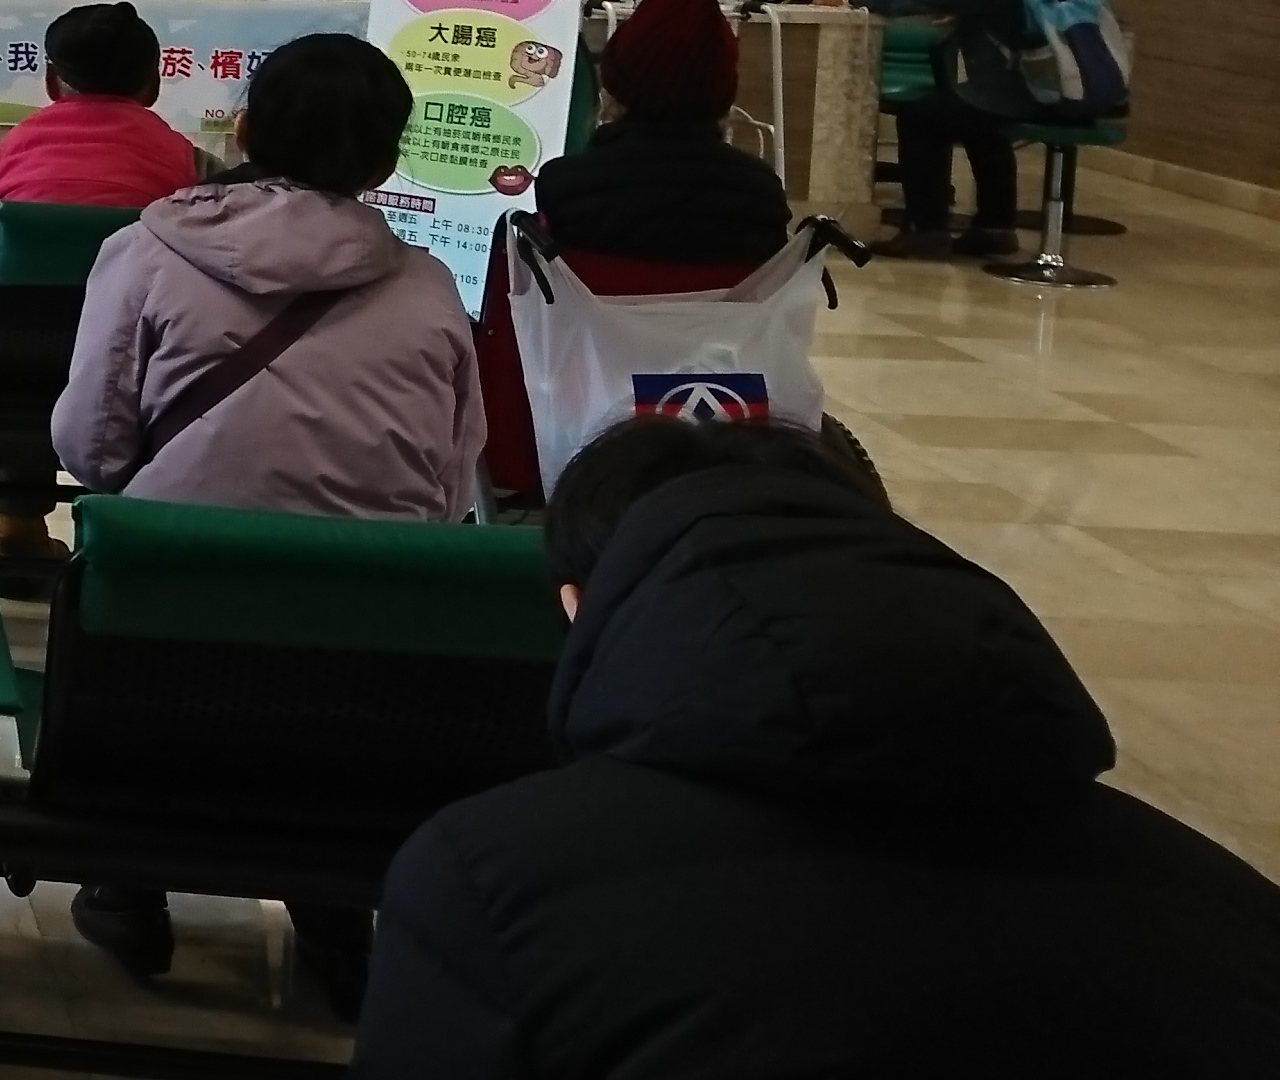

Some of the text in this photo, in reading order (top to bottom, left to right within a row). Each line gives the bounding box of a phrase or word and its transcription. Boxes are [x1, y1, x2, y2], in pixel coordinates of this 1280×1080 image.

[428, 23, 497, 48] 大腸癌
[205, 109, 224, 118] NO
[424, 102, 492, 128] 口腔癌
[429, 218, 453, 231] 上午
[429, 233, 451, 247] 下午
